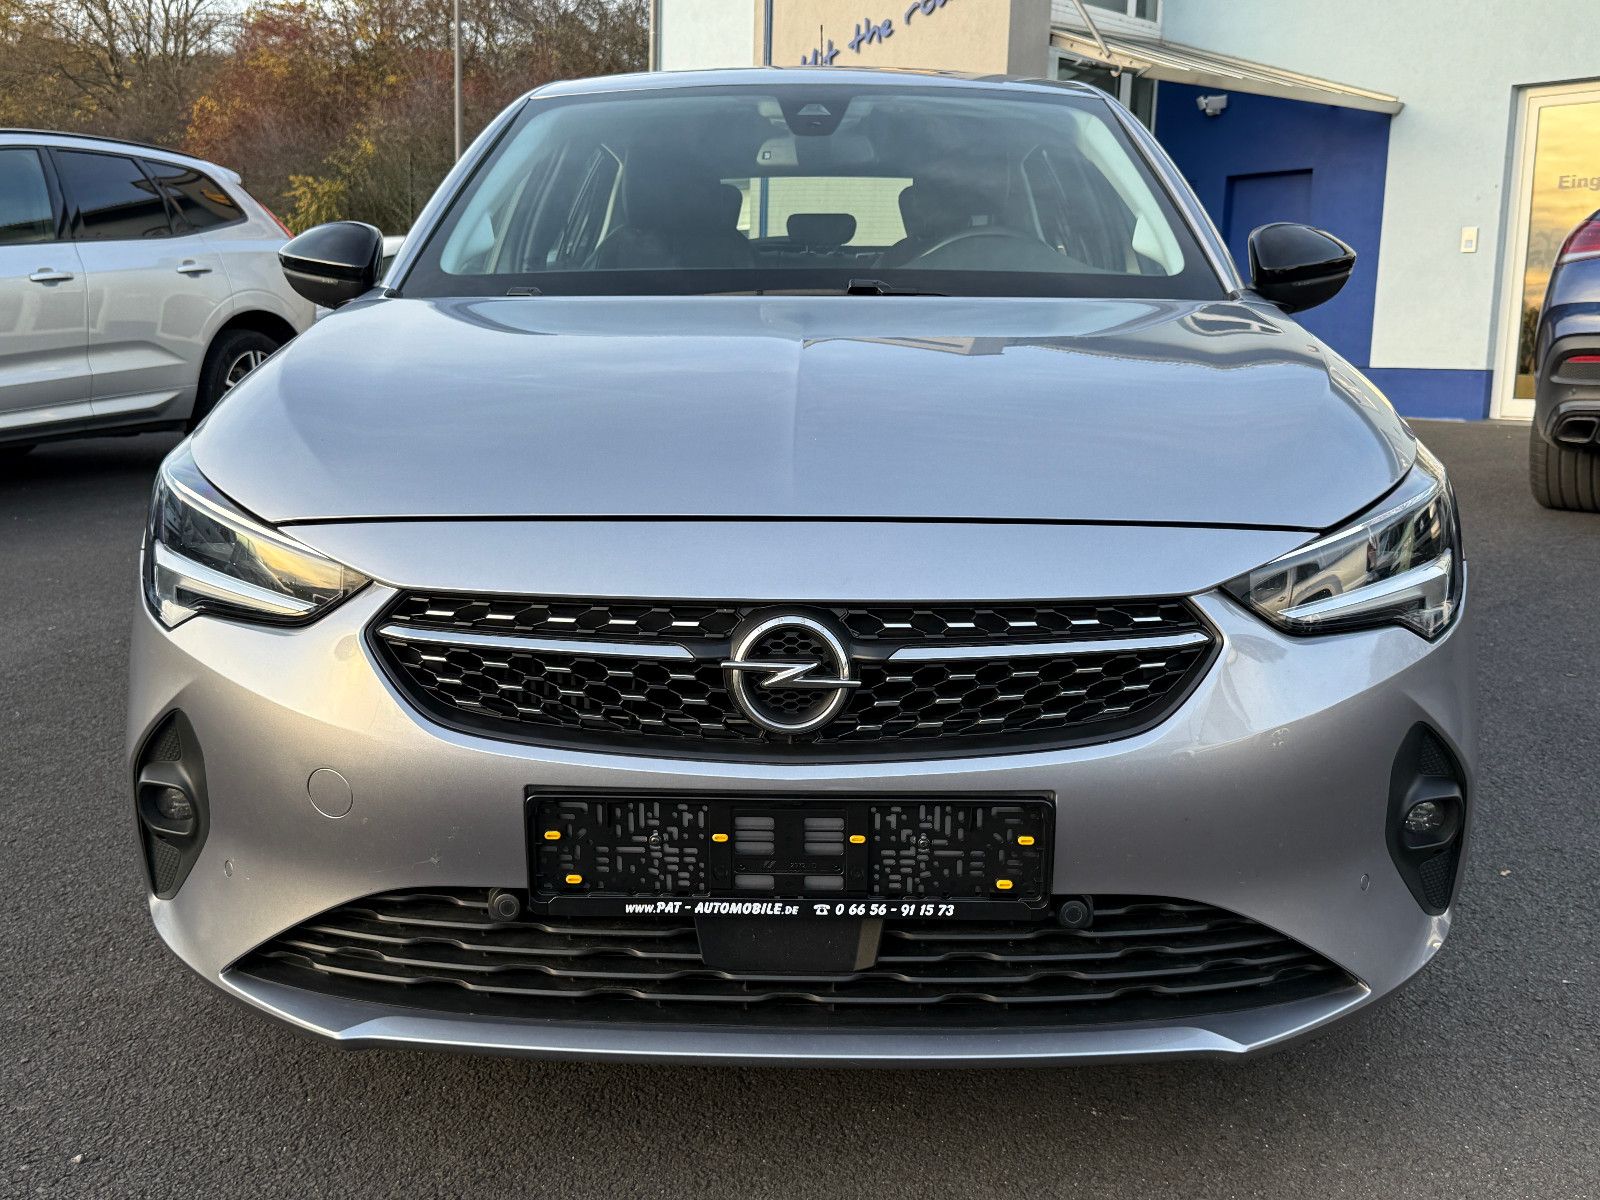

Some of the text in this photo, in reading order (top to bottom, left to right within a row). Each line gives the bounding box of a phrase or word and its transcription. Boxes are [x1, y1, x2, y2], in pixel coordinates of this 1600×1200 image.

[847, 17, 896, 54] the
[904, 0, 948, 26] ro
[1558, 174, 1600, 192] Eing
[625, 901, 683, 914] www.PAT
[694, 901, 800, 916] AUTOMOBILE.DE
[834, 903, 845, 916] 0
[848, 903, 866, 916] 66
[869, 903, 888, 916] 56
[900, 904, 916, 917] 91
[919, 904, 935, 917] 15
[938, 904, 955, 917] 73
